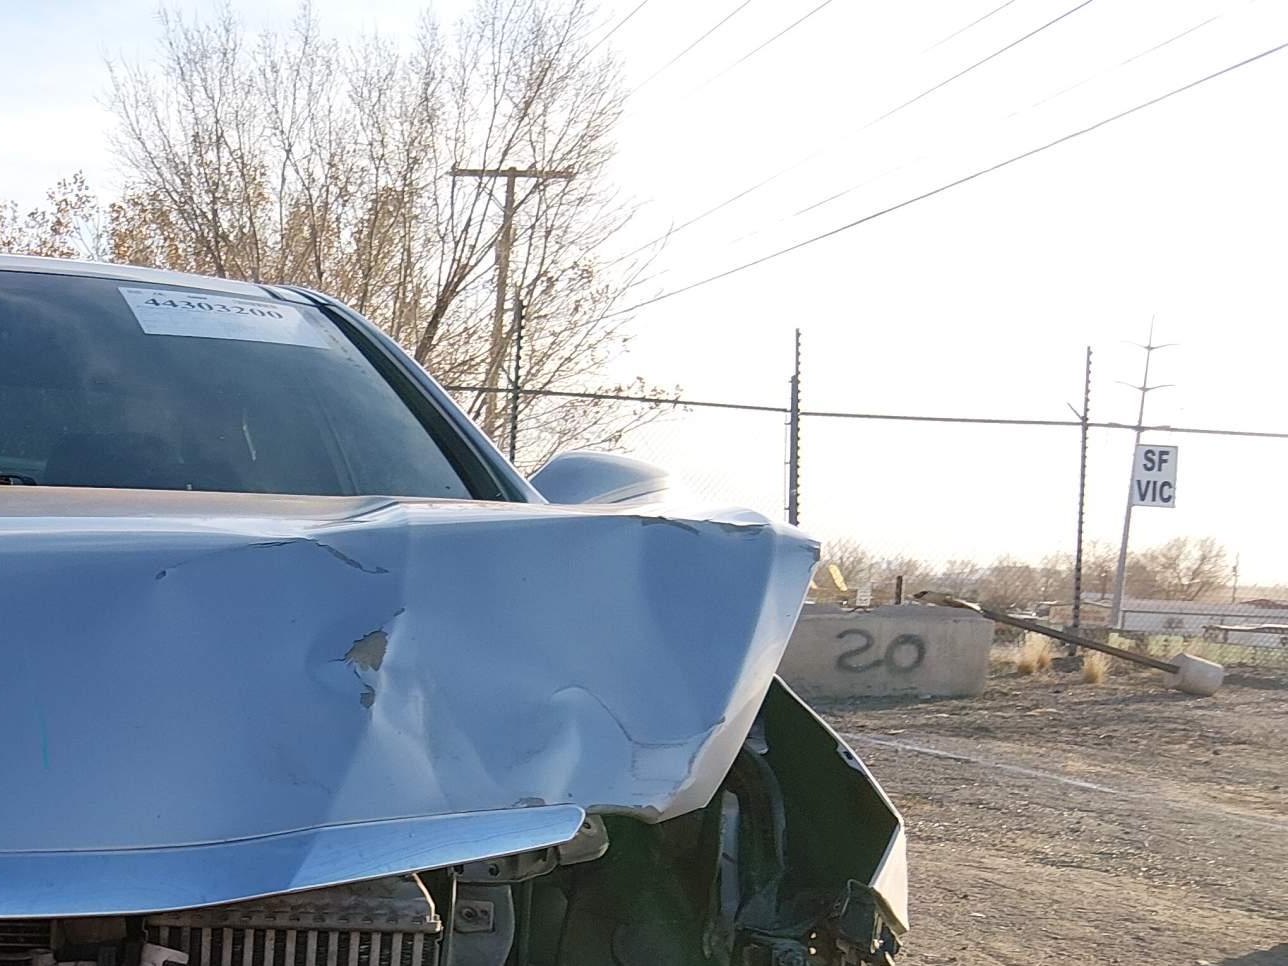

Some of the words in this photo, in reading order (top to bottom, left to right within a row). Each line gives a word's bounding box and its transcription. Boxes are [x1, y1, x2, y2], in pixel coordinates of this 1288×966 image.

[145, 297, 283, 320] 44303200
[1142, 448, 1171, 473] SF
[1135, 479, 1173, 504] VIC
[835, 628, 926, 673] 20
